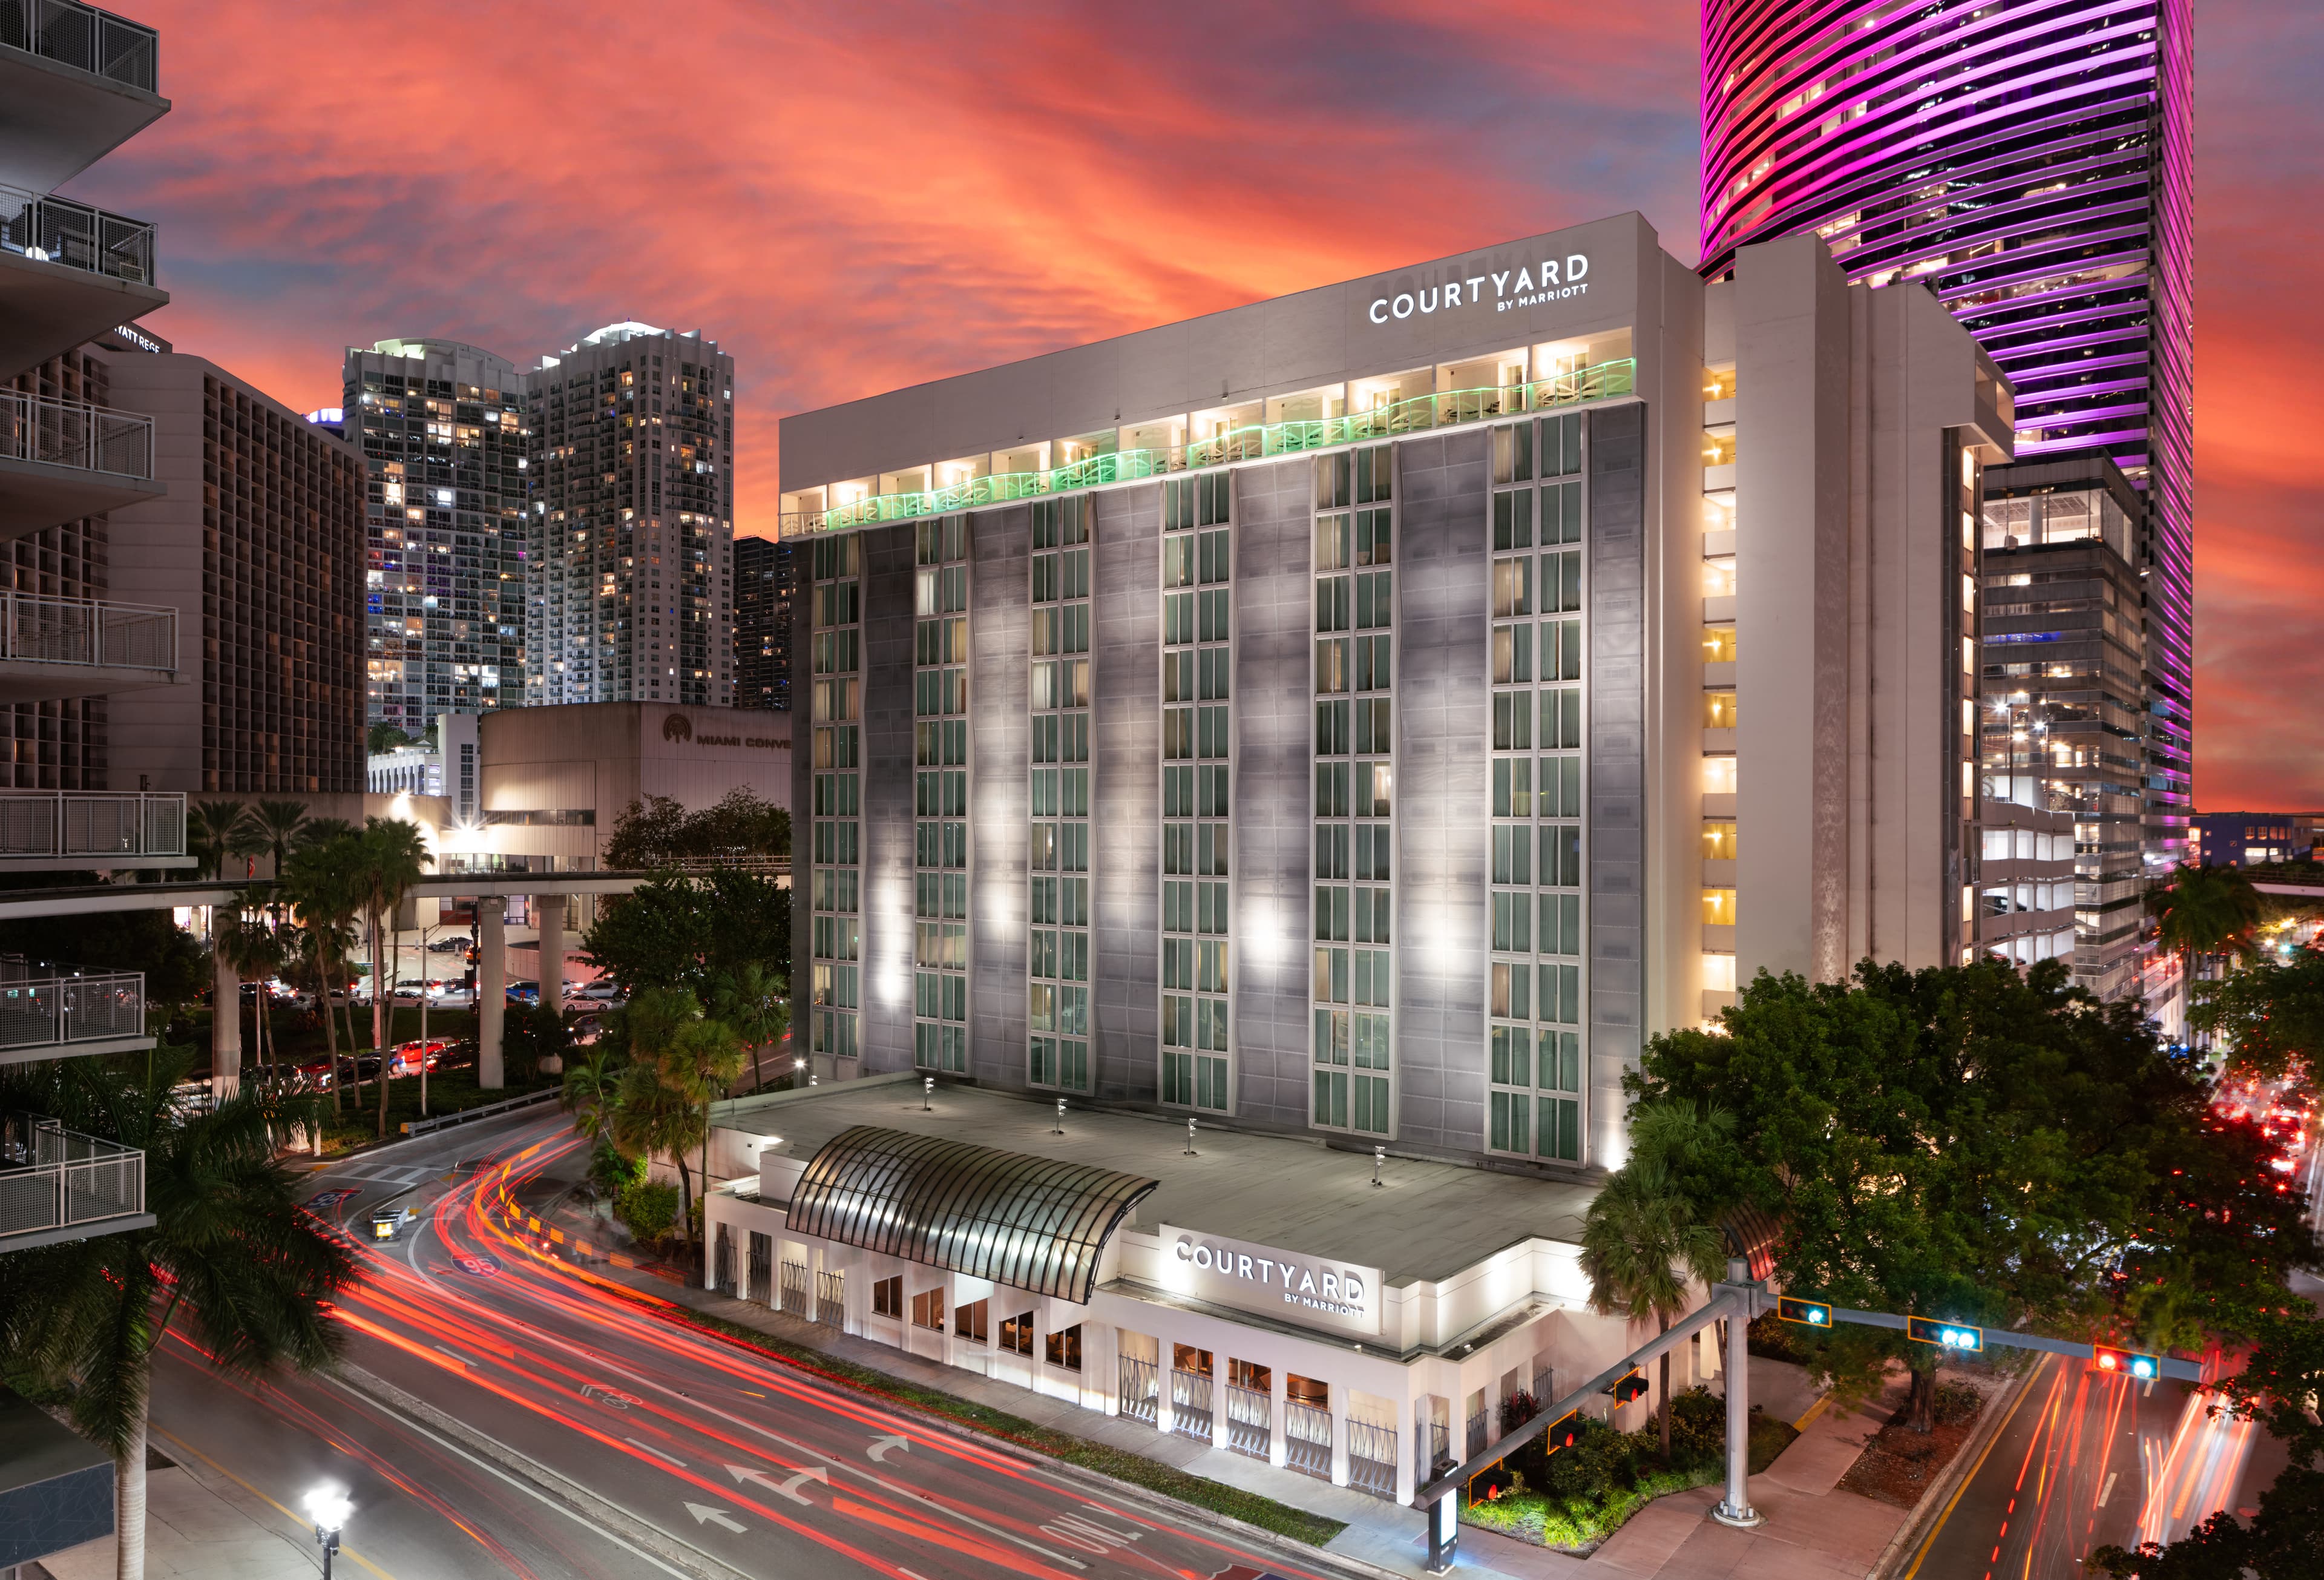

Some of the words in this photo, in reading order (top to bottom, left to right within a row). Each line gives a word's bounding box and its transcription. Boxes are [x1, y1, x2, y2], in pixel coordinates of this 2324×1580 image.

[1369, 254, 1589, 324] COURTYARD
[1497, 300, 1514, 312] BY
[1518, 283, 1589, 308] MARRIOTT
[114, 325, 138, 343] YATT
[697, 735, 741, 746] MIAMI
[309, 1194, 349, 1206] 95
[463, 1257, 496, 1274] 95
[1174, 1242, 1365, 1303] COURTYARD
[1284, 1292, 1299, 1304] BY
[1303, 1297, 1365, 1318] MARRIOTT
